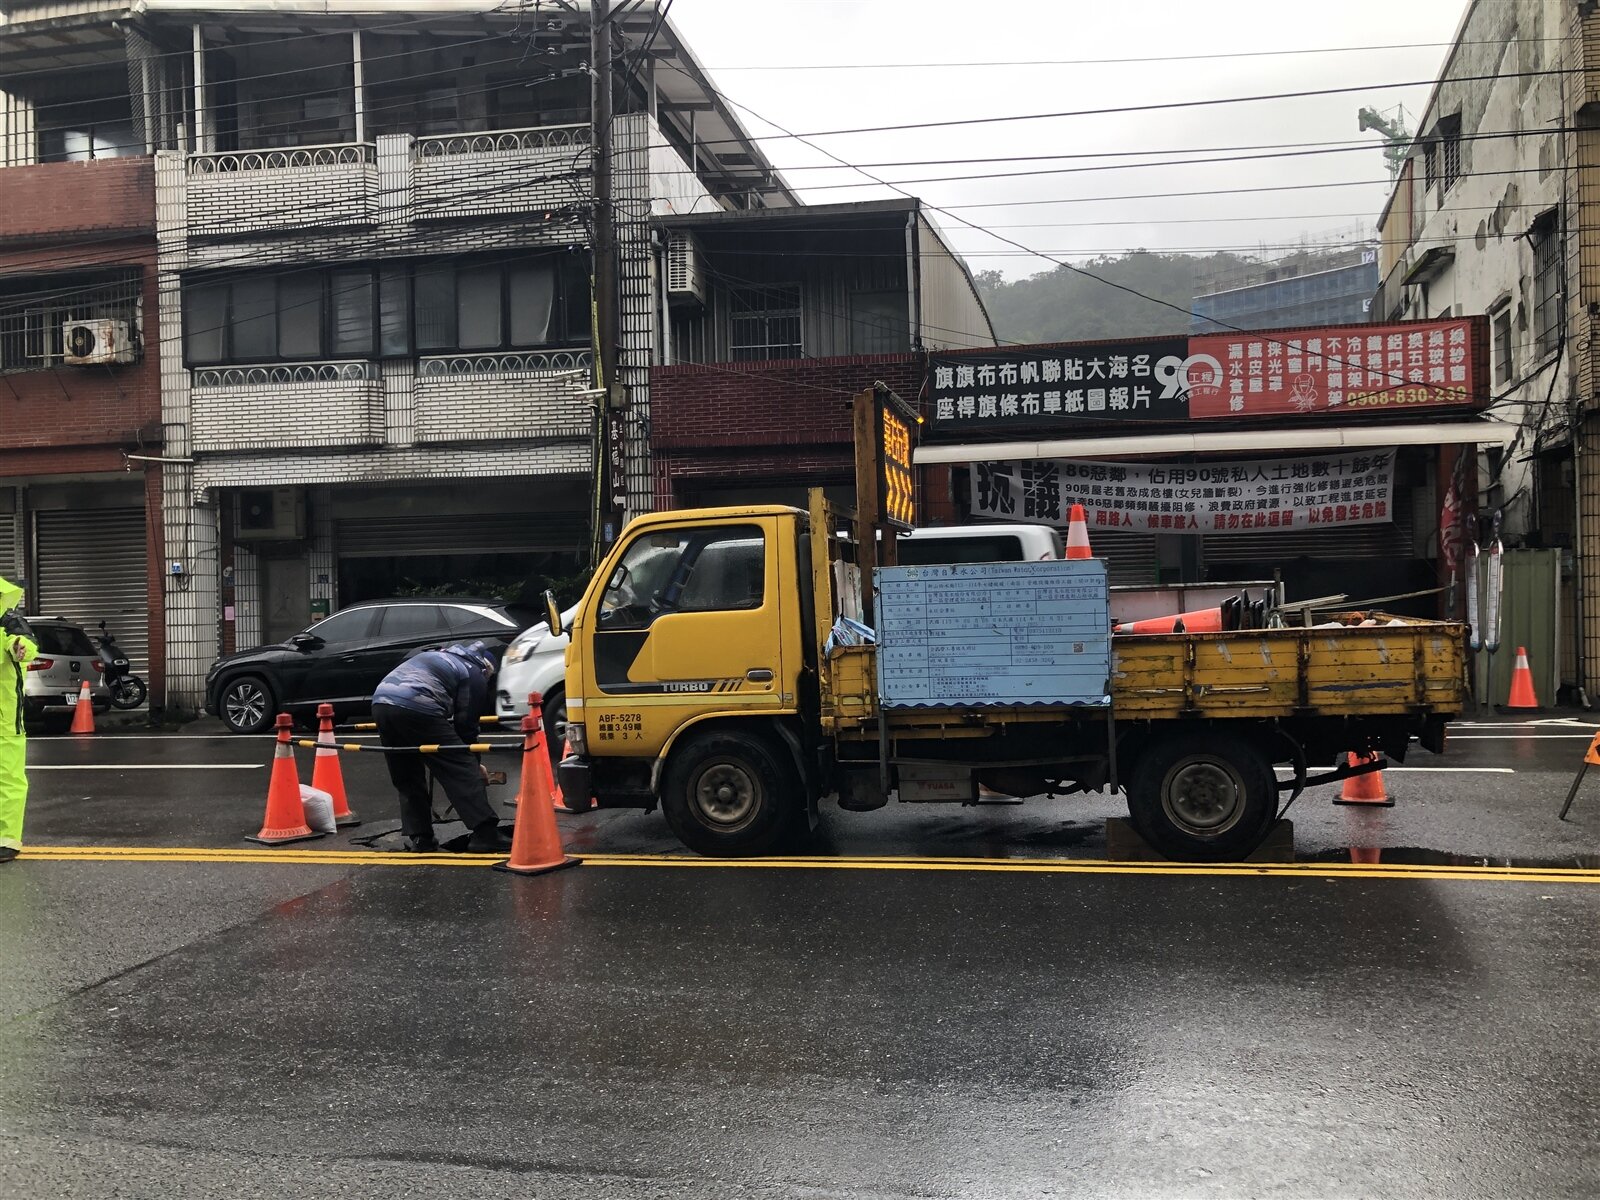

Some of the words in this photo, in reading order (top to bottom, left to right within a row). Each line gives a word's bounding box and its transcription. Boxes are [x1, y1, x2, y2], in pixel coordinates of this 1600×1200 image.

[1363, 252, 1373, 263] 12
[1154, 353, 1224, 400] 90
[1189, 371, 1213, 384] 工程
[1228, 343, 1244, 412] 漏水查修
[1247, 342, 1263, 393] 鐵皮屋
[1267, 341, 1283, 392] 採光罩
[1287, 339, 1302, 374] 鐵窗
[1307, 338, 1322, 373] 鐵門
[1347, 337, 1362, 388] 冷氣架
[1367, 335, 1383, 388] 鐵捲門
[1387, 333, 1403, 386] 鋁門窗
[1408, 332, 1424, 384] 換五金
[1428, 330, 1445, 383] 換玻璃
[1449, 327, 1466, 382] 換紗窗
[977, 460, 1061, 520] 抗議
[661, 682, 709, 692] TURBO
[599, 714, 641, 723] ABF-5278
[622, 732, 628, 740] 3
[635, 732, 643, 741] 人
